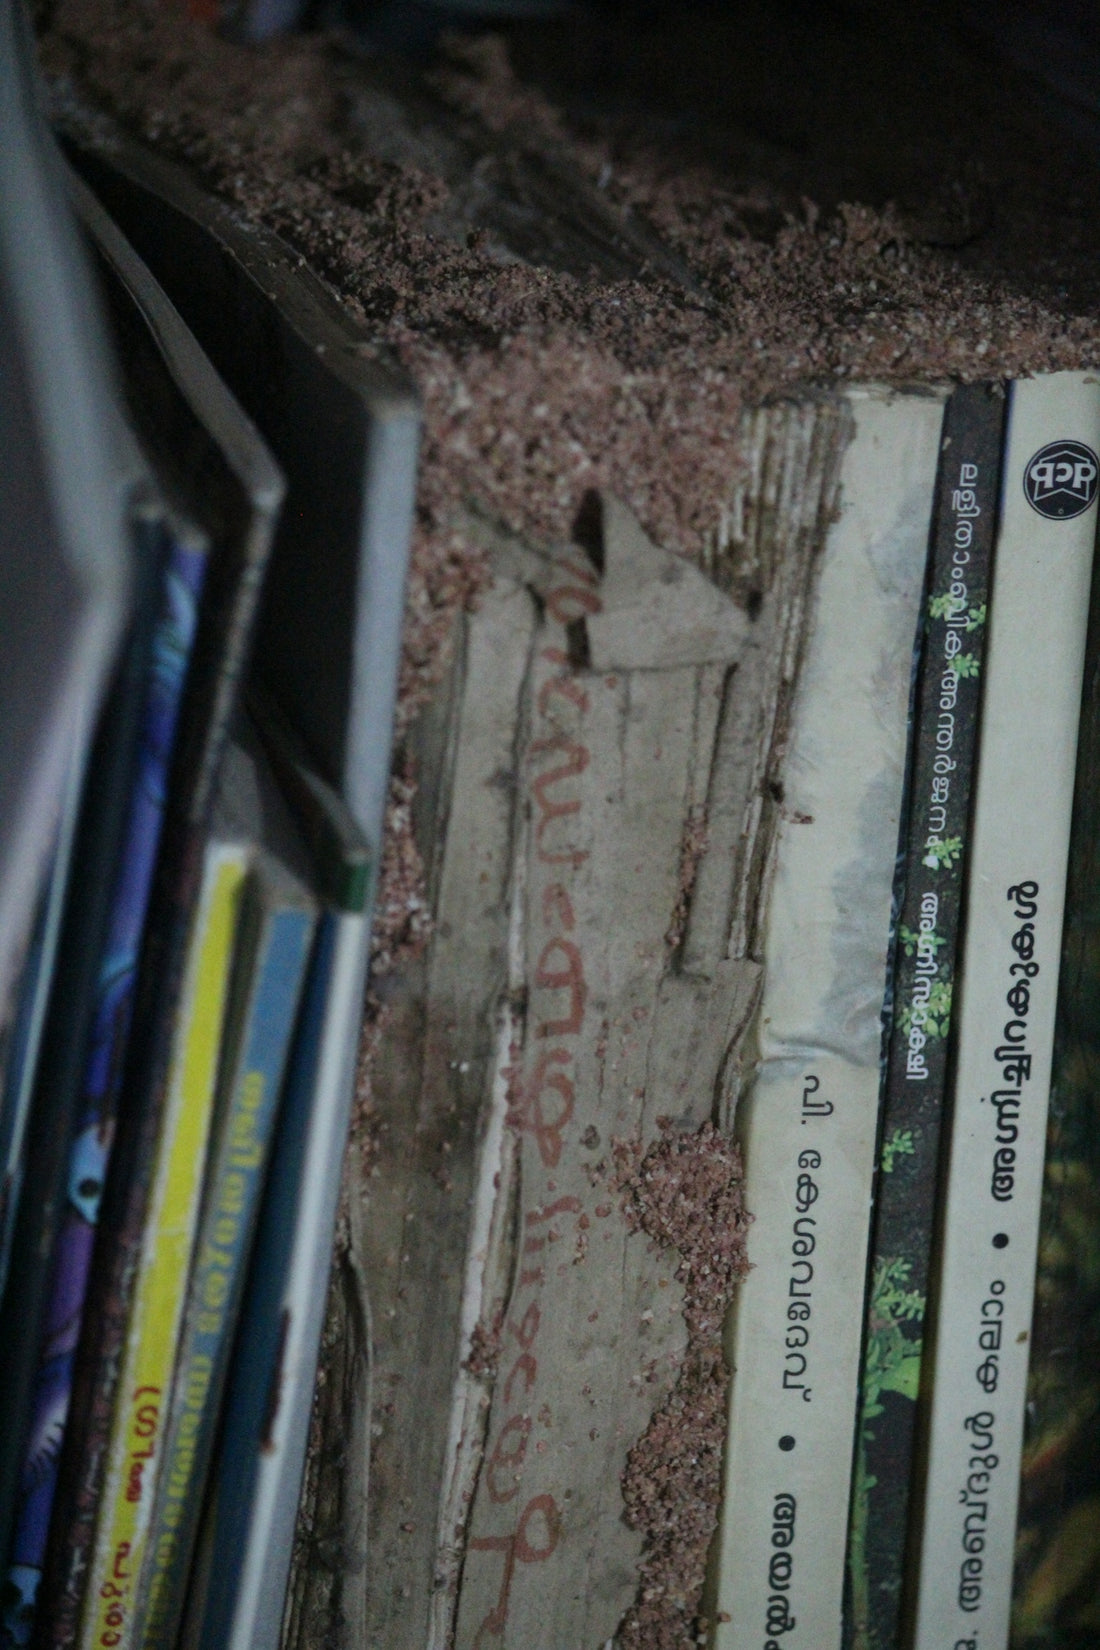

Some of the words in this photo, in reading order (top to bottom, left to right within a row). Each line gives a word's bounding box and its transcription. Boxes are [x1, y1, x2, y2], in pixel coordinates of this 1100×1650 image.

[800, 1074, 835, 1126] പി.
[989, 879, 1041, 1203] അഗ്നിച്ചിറകുകൾ
[781, 1148, 822, 1403] കേശവദേവ്
[975, 1279, 1007, 1391] കലാം
